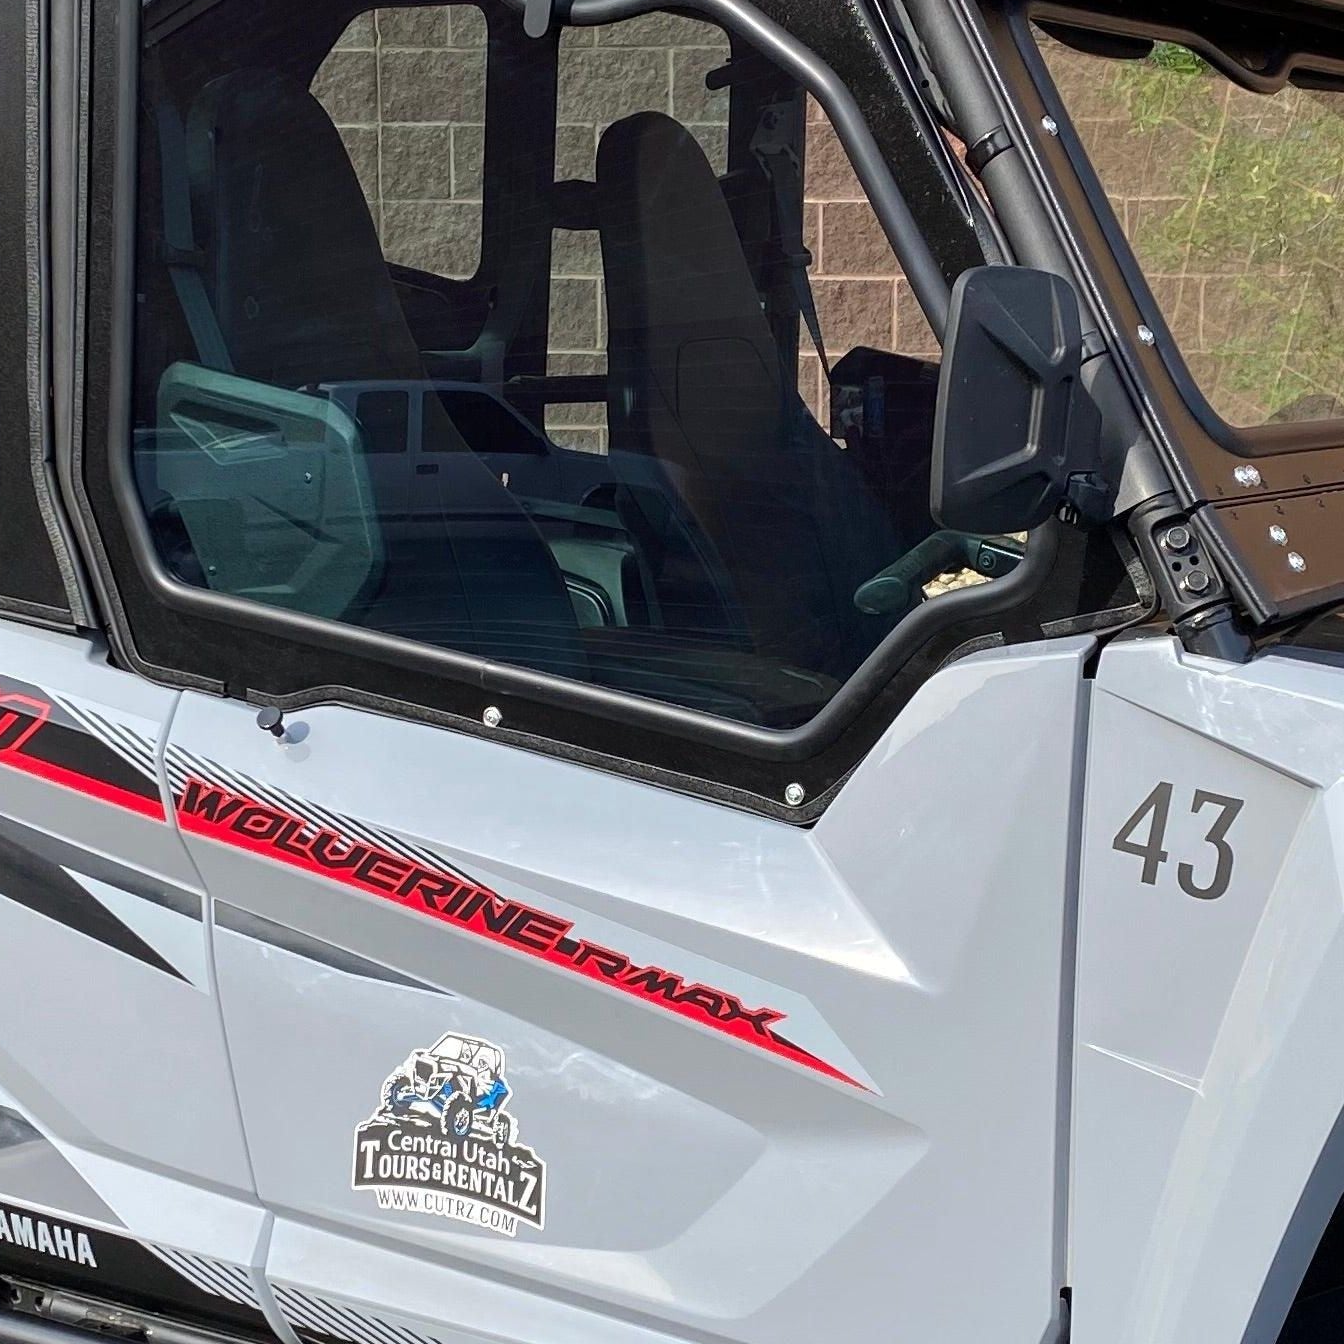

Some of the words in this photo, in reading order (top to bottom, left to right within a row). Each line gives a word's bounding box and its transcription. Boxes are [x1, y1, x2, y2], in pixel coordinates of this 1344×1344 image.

[182, 778, 574, 952] WOLVERINE
[1112, 781, 1244, 900] 43
[388, 1130, 457, 1158] Central
[463, 1140, 511, 1176] Utah
